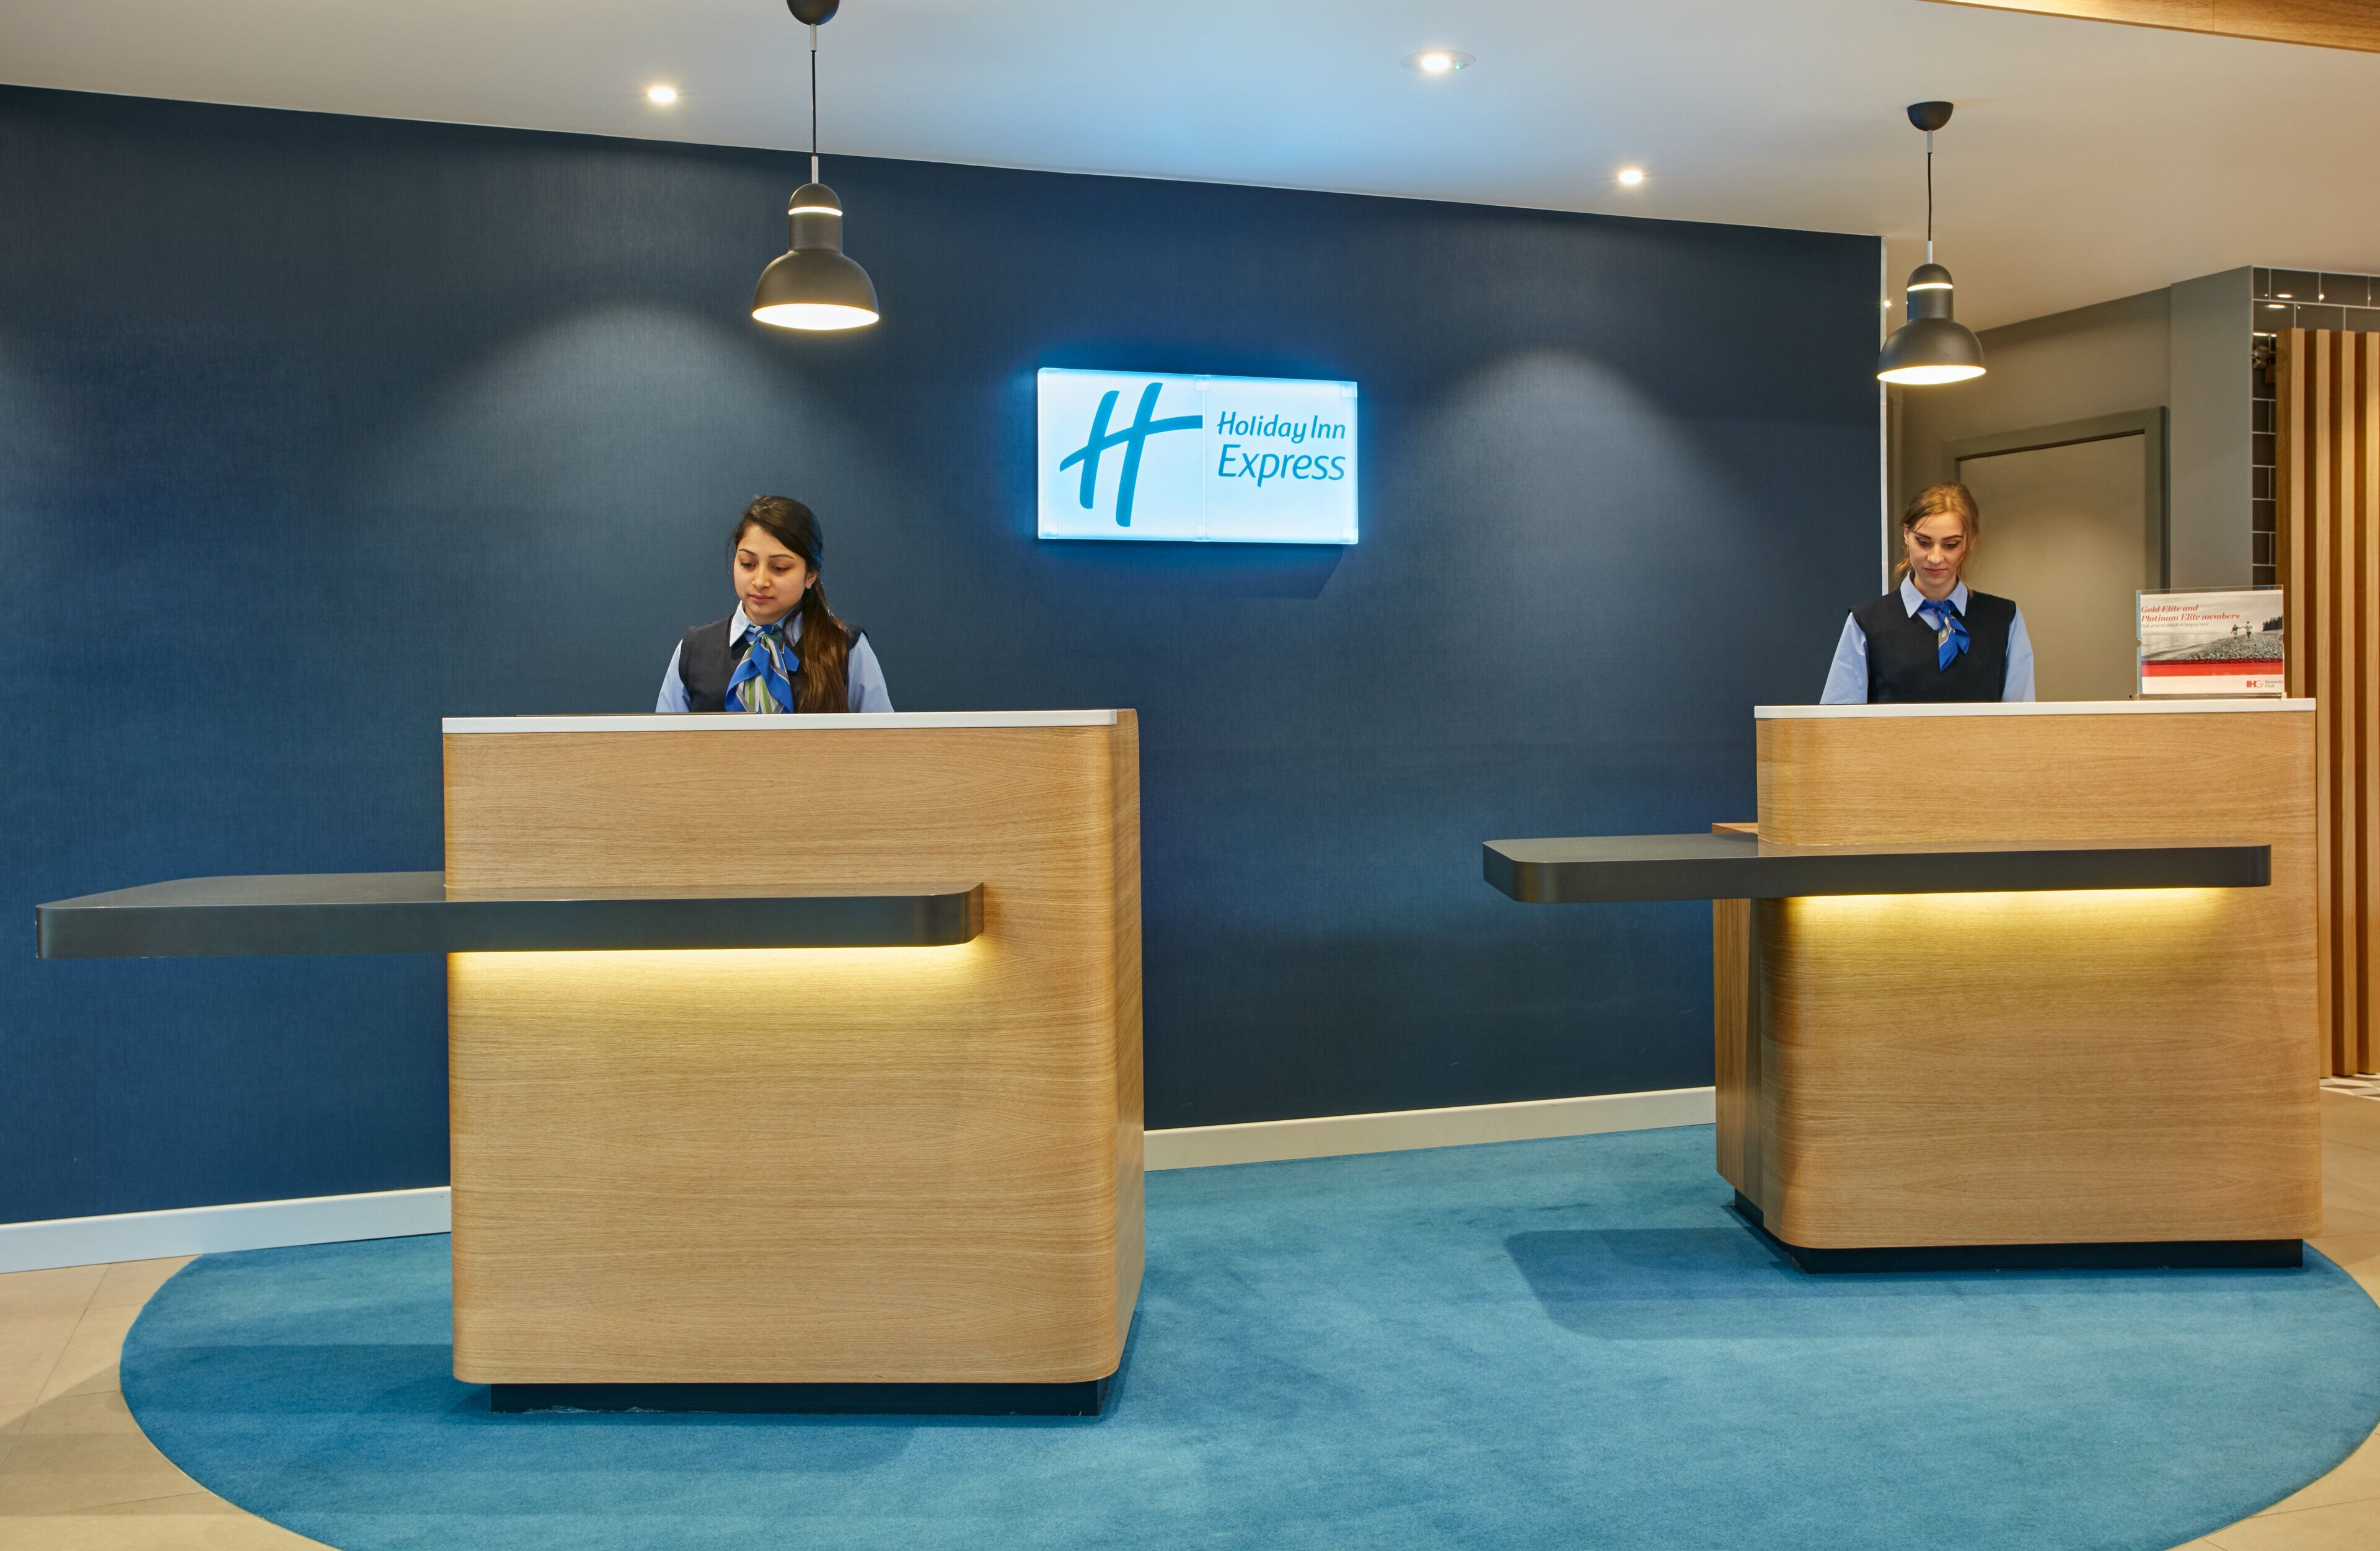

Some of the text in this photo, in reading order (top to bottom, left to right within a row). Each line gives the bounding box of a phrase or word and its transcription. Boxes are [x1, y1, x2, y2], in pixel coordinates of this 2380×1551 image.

[1217, 411, 1346, 444] Holiday Inn
[1218, 443, 1346, 488] Express
